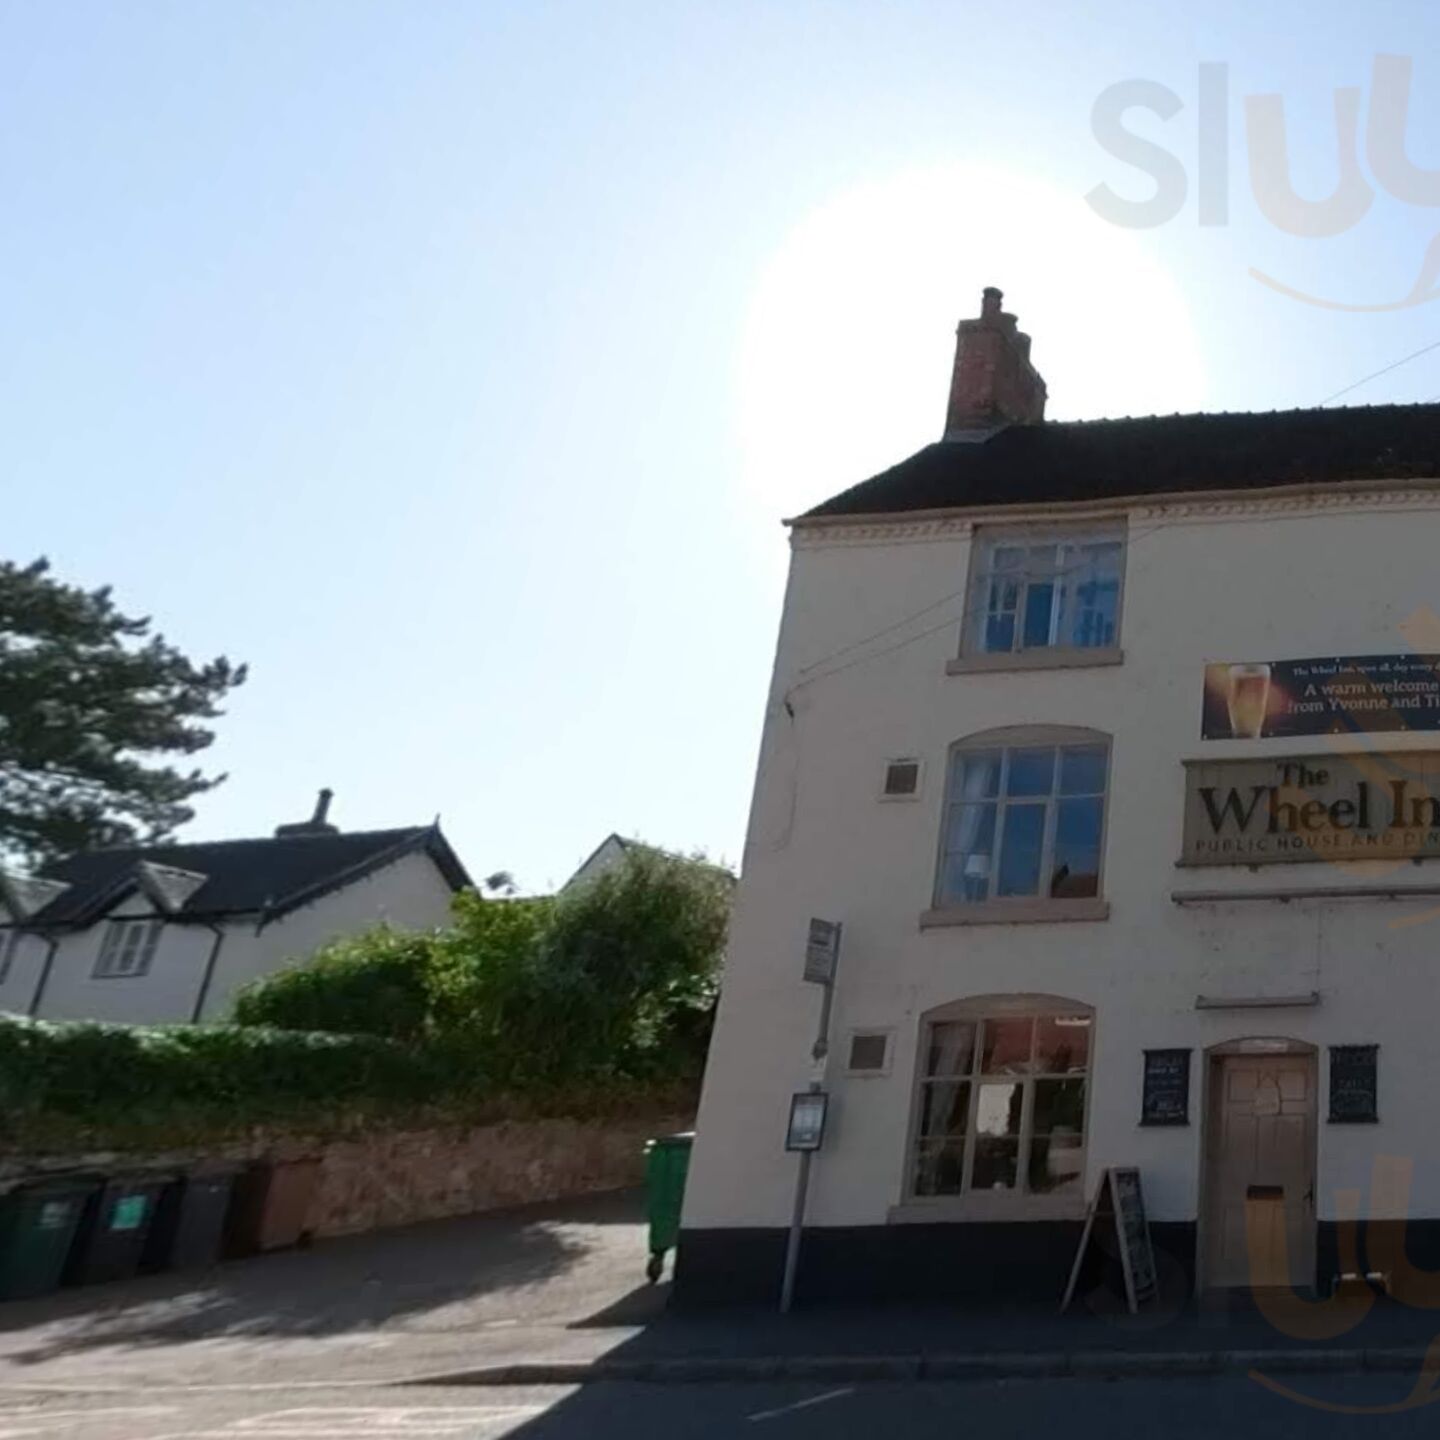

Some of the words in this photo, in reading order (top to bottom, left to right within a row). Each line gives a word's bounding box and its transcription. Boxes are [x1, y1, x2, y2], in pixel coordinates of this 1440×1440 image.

[1311, 665, 1336, 675] Wheel
[1304, 683, 1317, 696] A
[1321, 683, 1366, 695] warm
[1370, 680, 1439, 693] welcome
[1288, 700, 1324, 713] from
[1328, 697, 1389, 711] Yvonne
[1391, 695, 1421, 708] and
[1277, 761, 1329, 787] The
[1198, 781, 1369, 835] Wheel
[1196, 838, 1266, 852] PUBLIC
[1277, 835, 1340, 849] HOUSE
[1351, 832, 1395, 847] AND
